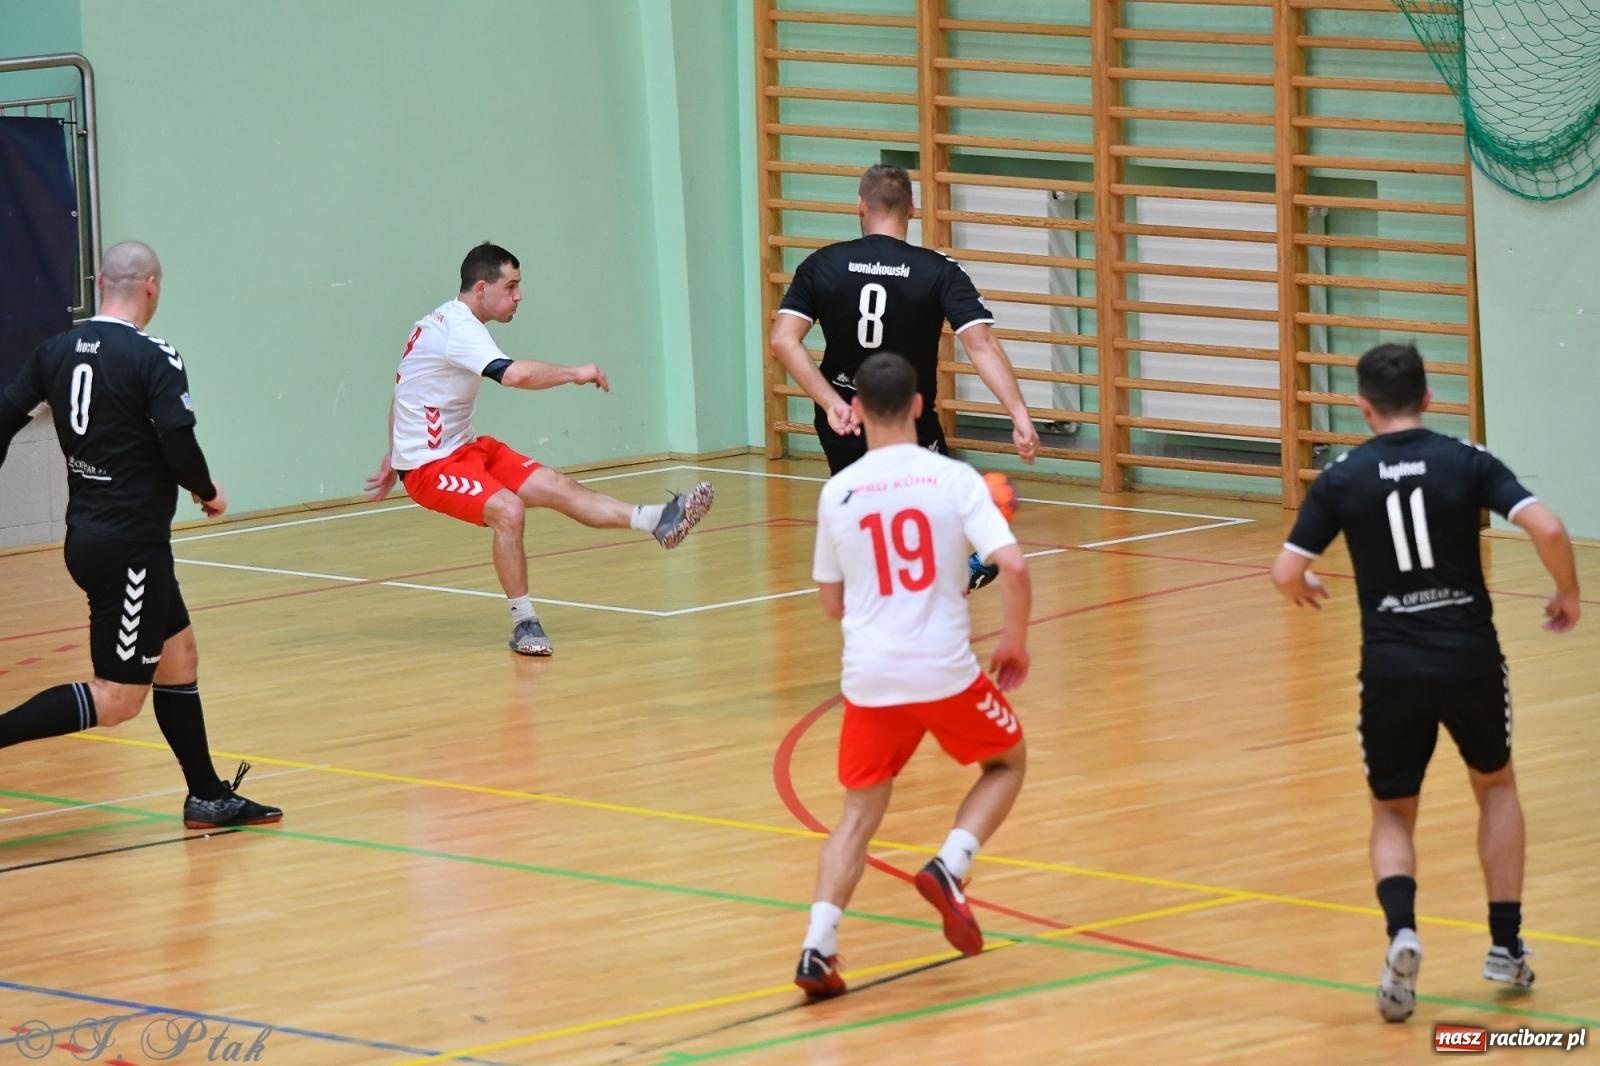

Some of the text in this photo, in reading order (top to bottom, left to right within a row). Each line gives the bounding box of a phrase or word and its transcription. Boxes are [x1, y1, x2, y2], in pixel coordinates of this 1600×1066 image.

[848, 261, 910, 278] woniakowski
[857, 282, 887, 349] 8
[70, 363, 93, 435] 0
[859, 508, 937, 597] 19
[1386, 486, 1434, 572] 11
